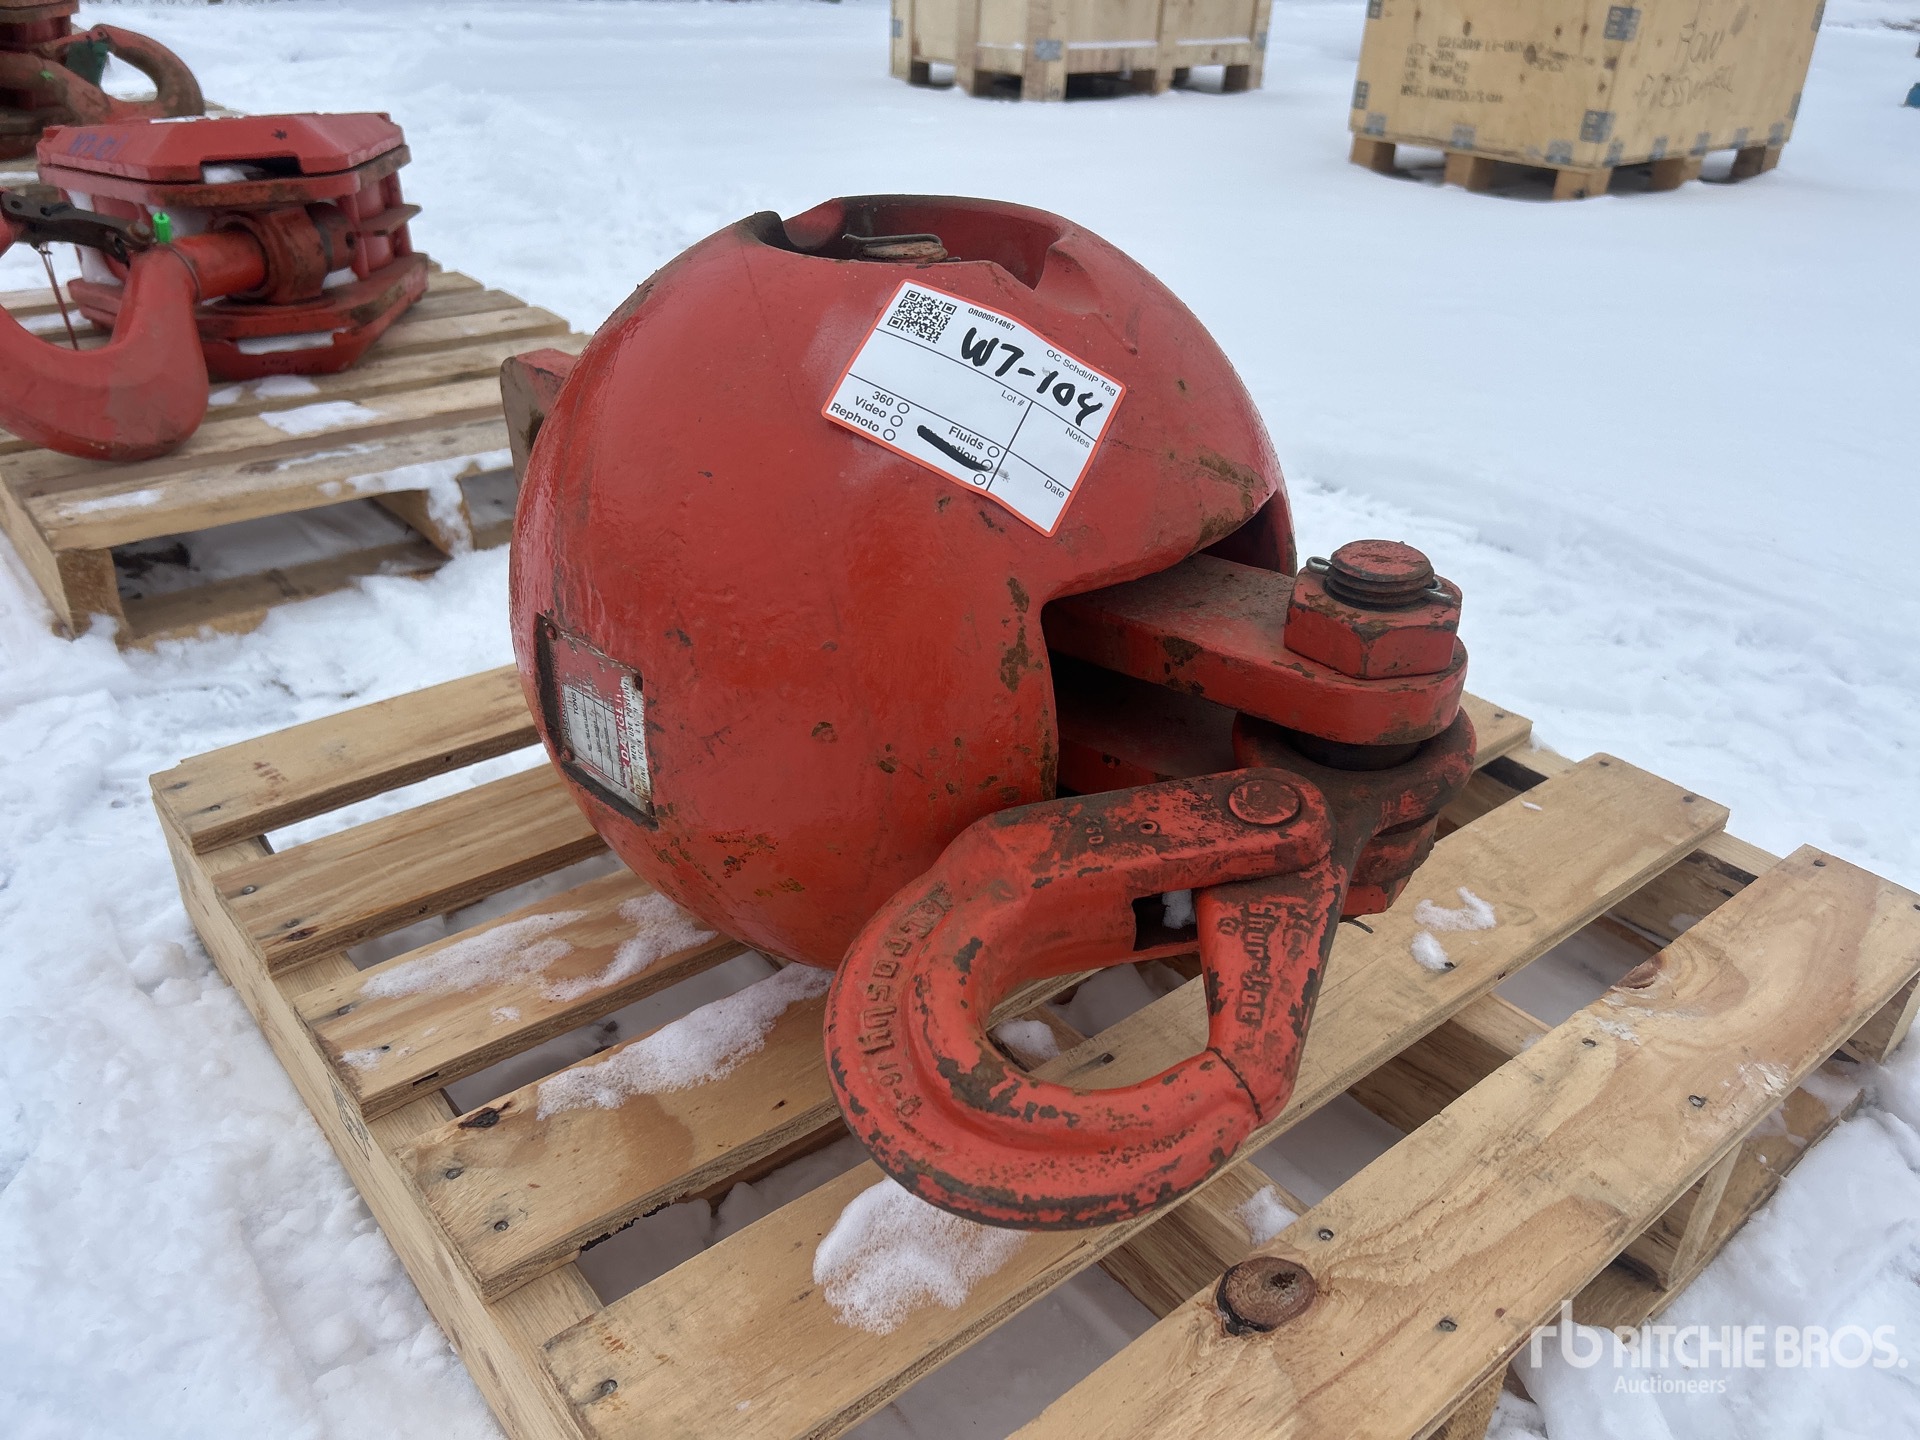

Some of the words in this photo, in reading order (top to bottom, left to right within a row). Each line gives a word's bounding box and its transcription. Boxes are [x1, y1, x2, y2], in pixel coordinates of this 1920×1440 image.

[961, 326, 1104, 427] W7-104
[1046, 349, 1063, 362] OC
[1100, 380, 1117, 396] Tag
[855, 395, 887, 418] Video
[872, 390, 894, 407] 360
[1001, 389, 1018, 405] Lot
[1015, 399, 1026, 407] #
[830, 402, 880, 433] Rephoto
[948, 425, 984, 450] Fluids
[1065, 427, 1090, 449] Notes
[1043, 479, 1065, 499] Date
[570, 691, 579, 716] TONS
